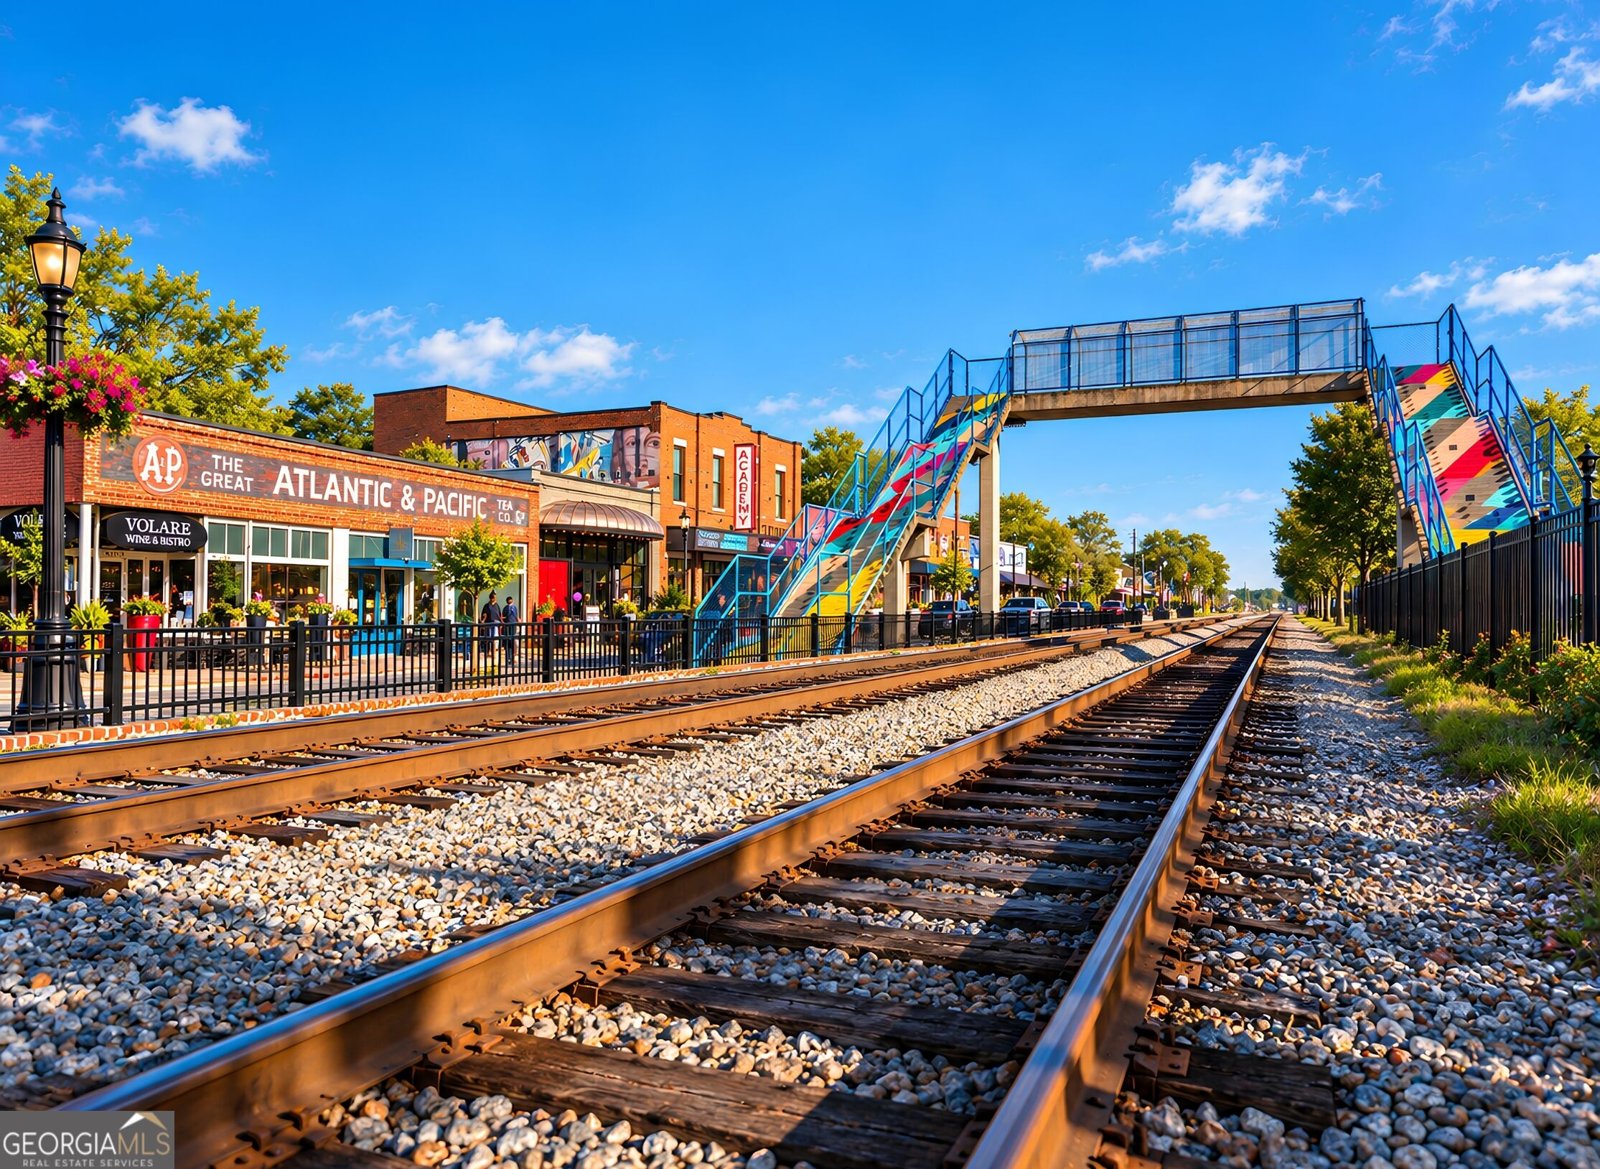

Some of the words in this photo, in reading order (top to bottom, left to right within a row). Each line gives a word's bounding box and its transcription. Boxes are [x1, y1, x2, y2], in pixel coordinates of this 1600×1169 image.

[211, 454, 244, 473] THE
[200, 471, 254, 493] GREAT
[272, 465, 392, 508] ATLANTIC
[401, 485, 416, 511] &
[424, 487, 487, 519] PACIFIC
[496, 499, 513, 511] TEA
[125, 517, 191, 536] VOLARE
